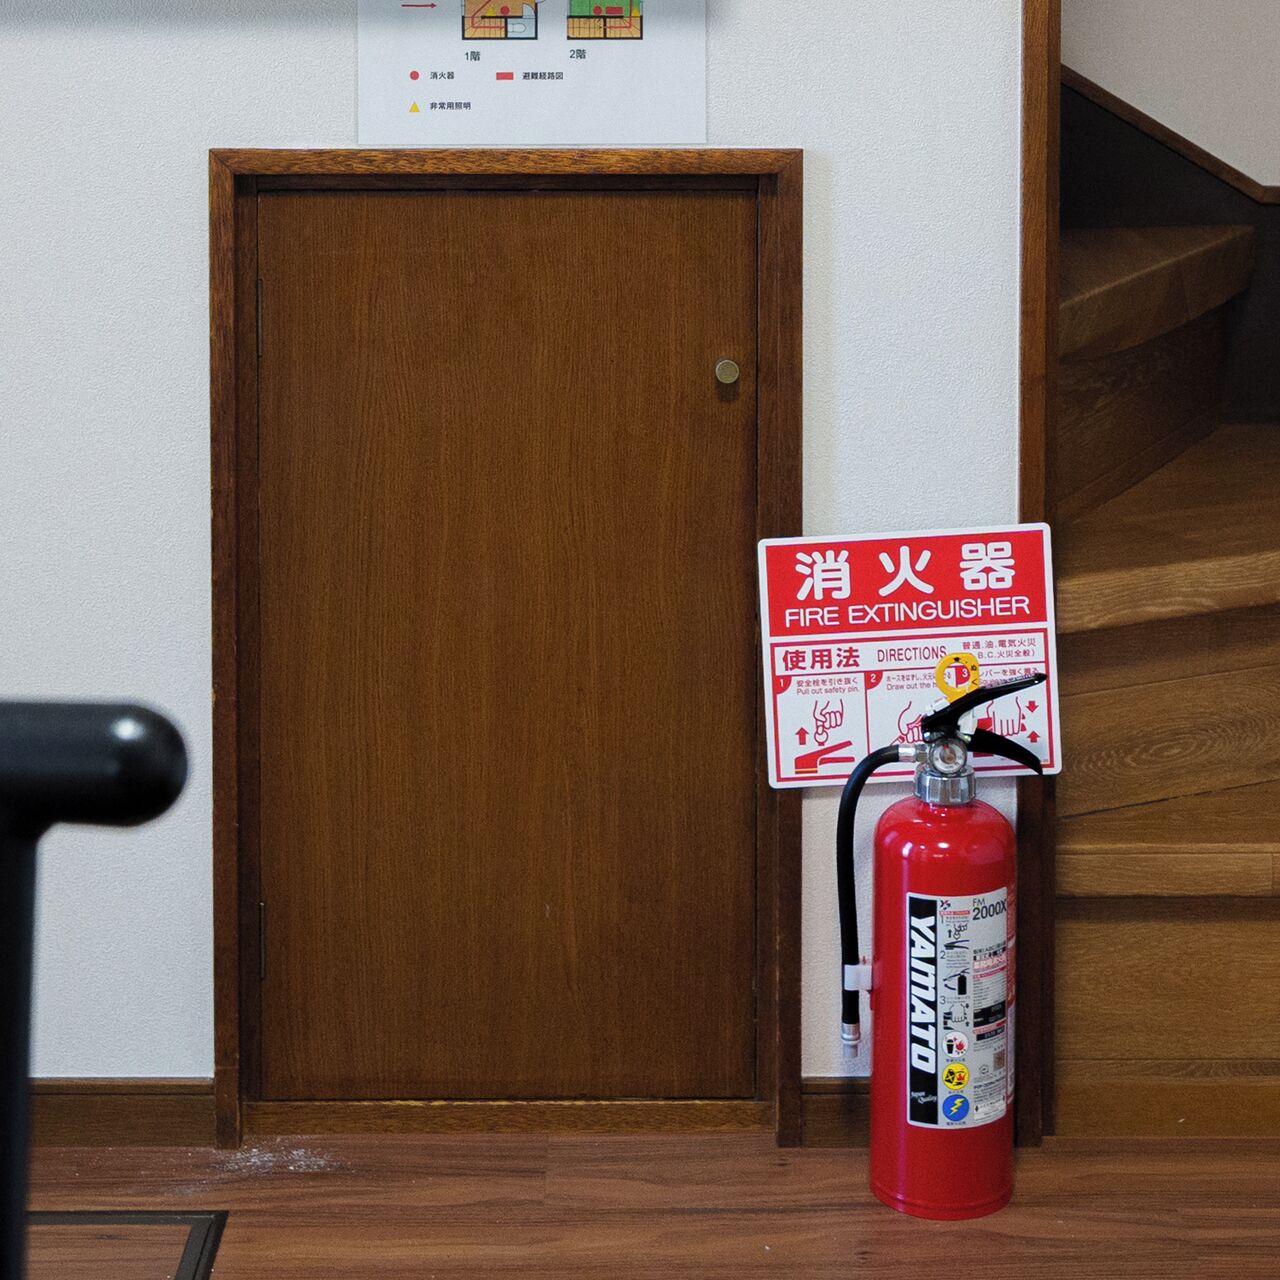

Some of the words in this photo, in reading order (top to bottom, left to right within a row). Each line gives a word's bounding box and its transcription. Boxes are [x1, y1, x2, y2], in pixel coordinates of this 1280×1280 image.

[465, 50, 481, 61] 1階
[569, 49, 587, 60] 2階
[430, 71, 455, 80] 消火器
[522, 72, 564, 80] 避難経路図
[430, 102, 471, 111] 非常用照明
[794, 541, 1016, 601] 消火器
[785, 606, 840, 628] FIRE
[848, 595, 1030, 623] EXTINGUISHER
[782, 646, 860, 671] 使用法
[877, 645, 947, 663] DIRECTIONS
[961, 668, 968, 678] 3
[780, 679, 784, 687] 1
[796, 677, 858, 687] 安全栓を引き抜く
[870, 674, 877, 683] 2
[797, 687, 810, 696] Pull
[811, 687, 823, 695] out
[824, 686, 846, 695] safety
[886, 683, 905, 691] Draw
[973, 898, 985, 907] FM
[972, 898, 1007, 921] 2000X
[940, 950, 946, 959] 2
[911, 915, 936, 1074] YAMATO
[940, 996, 946, 1005] 3
